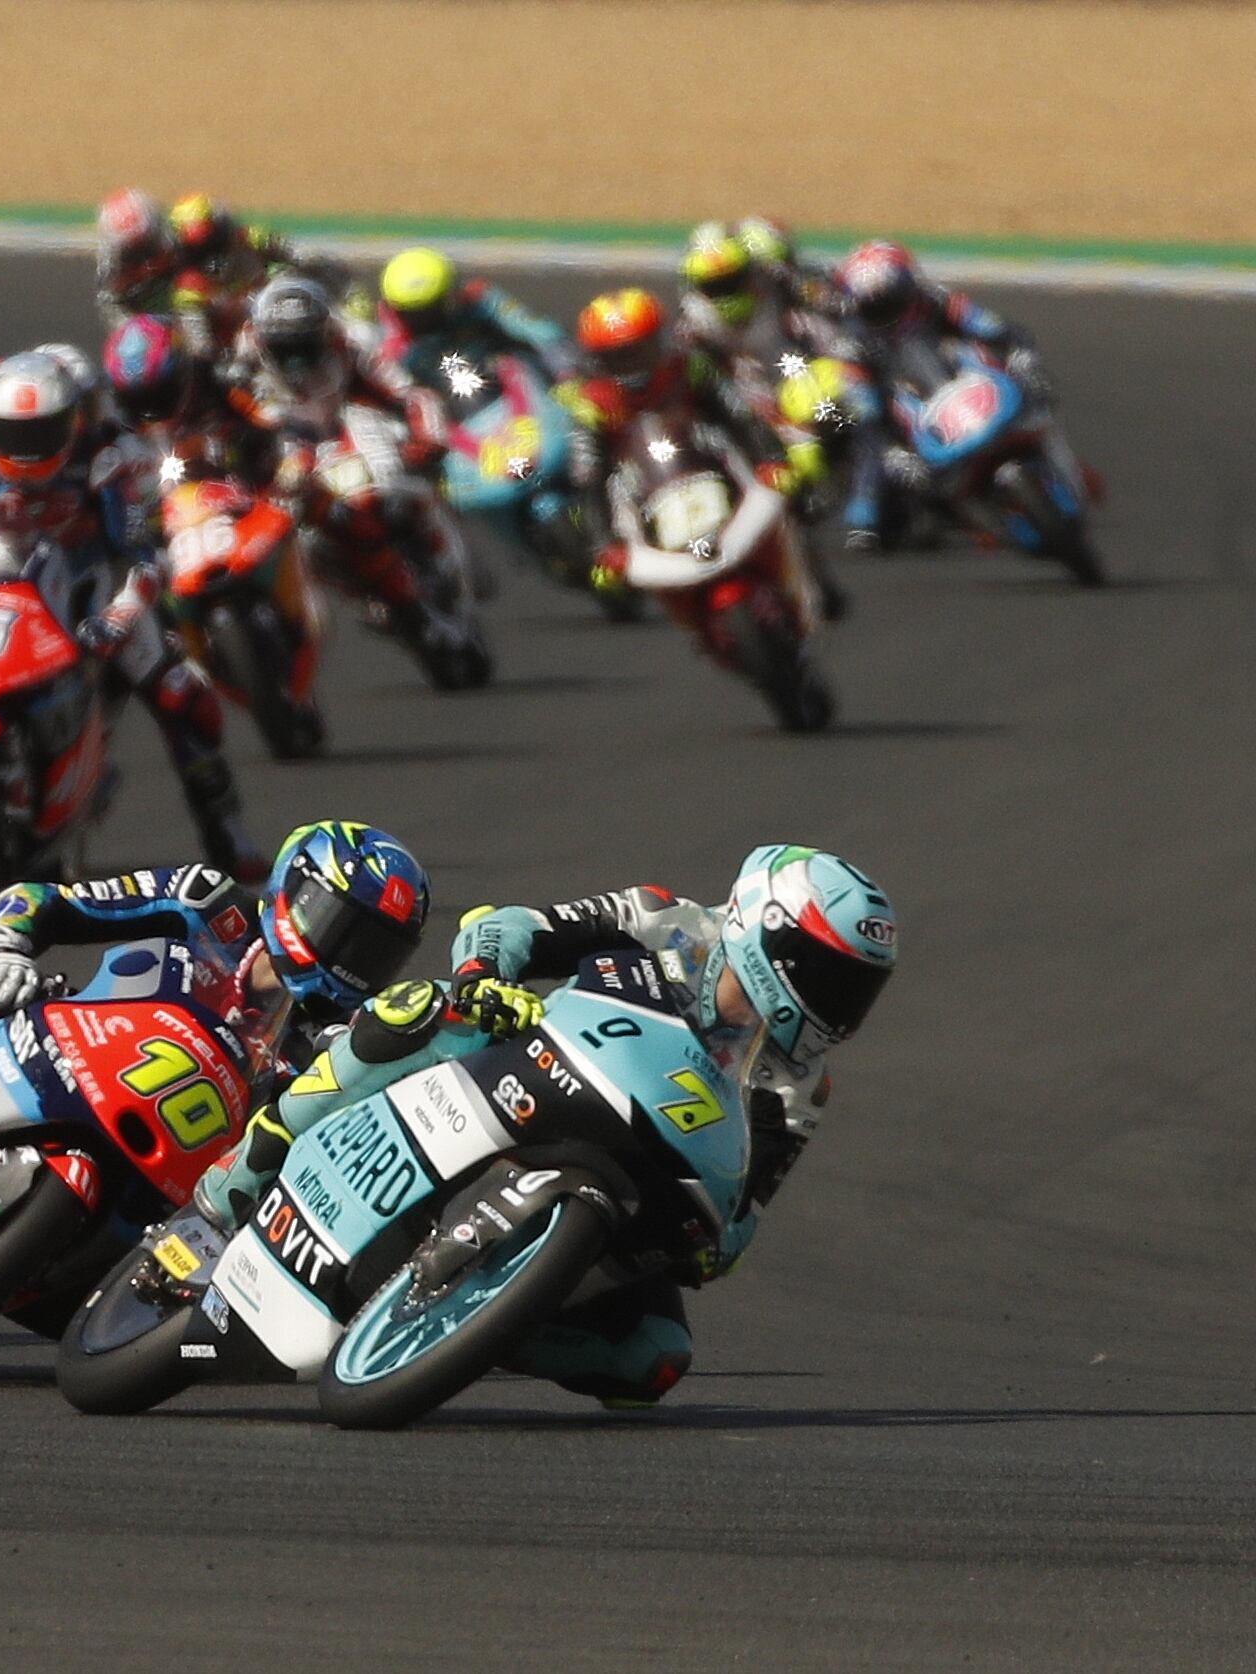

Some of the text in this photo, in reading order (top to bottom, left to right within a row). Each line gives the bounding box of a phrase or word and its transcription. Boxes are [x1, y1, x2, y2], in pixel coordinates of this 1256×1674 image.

[595, 957, 623, 990] DOVIT
[118, 1036, 232, 1151] 10
[527, 1038, 583, 1096] DOVIT
[423, 1073, 467, 1134] ANONIMO
[658, 1067, 728, 1136] 7
[317, 1103, 417, 1218] LEOPARD
[294, 1165, 343, 1231] NATURAL
[256, 1186, 334, 1286] DOVIT
